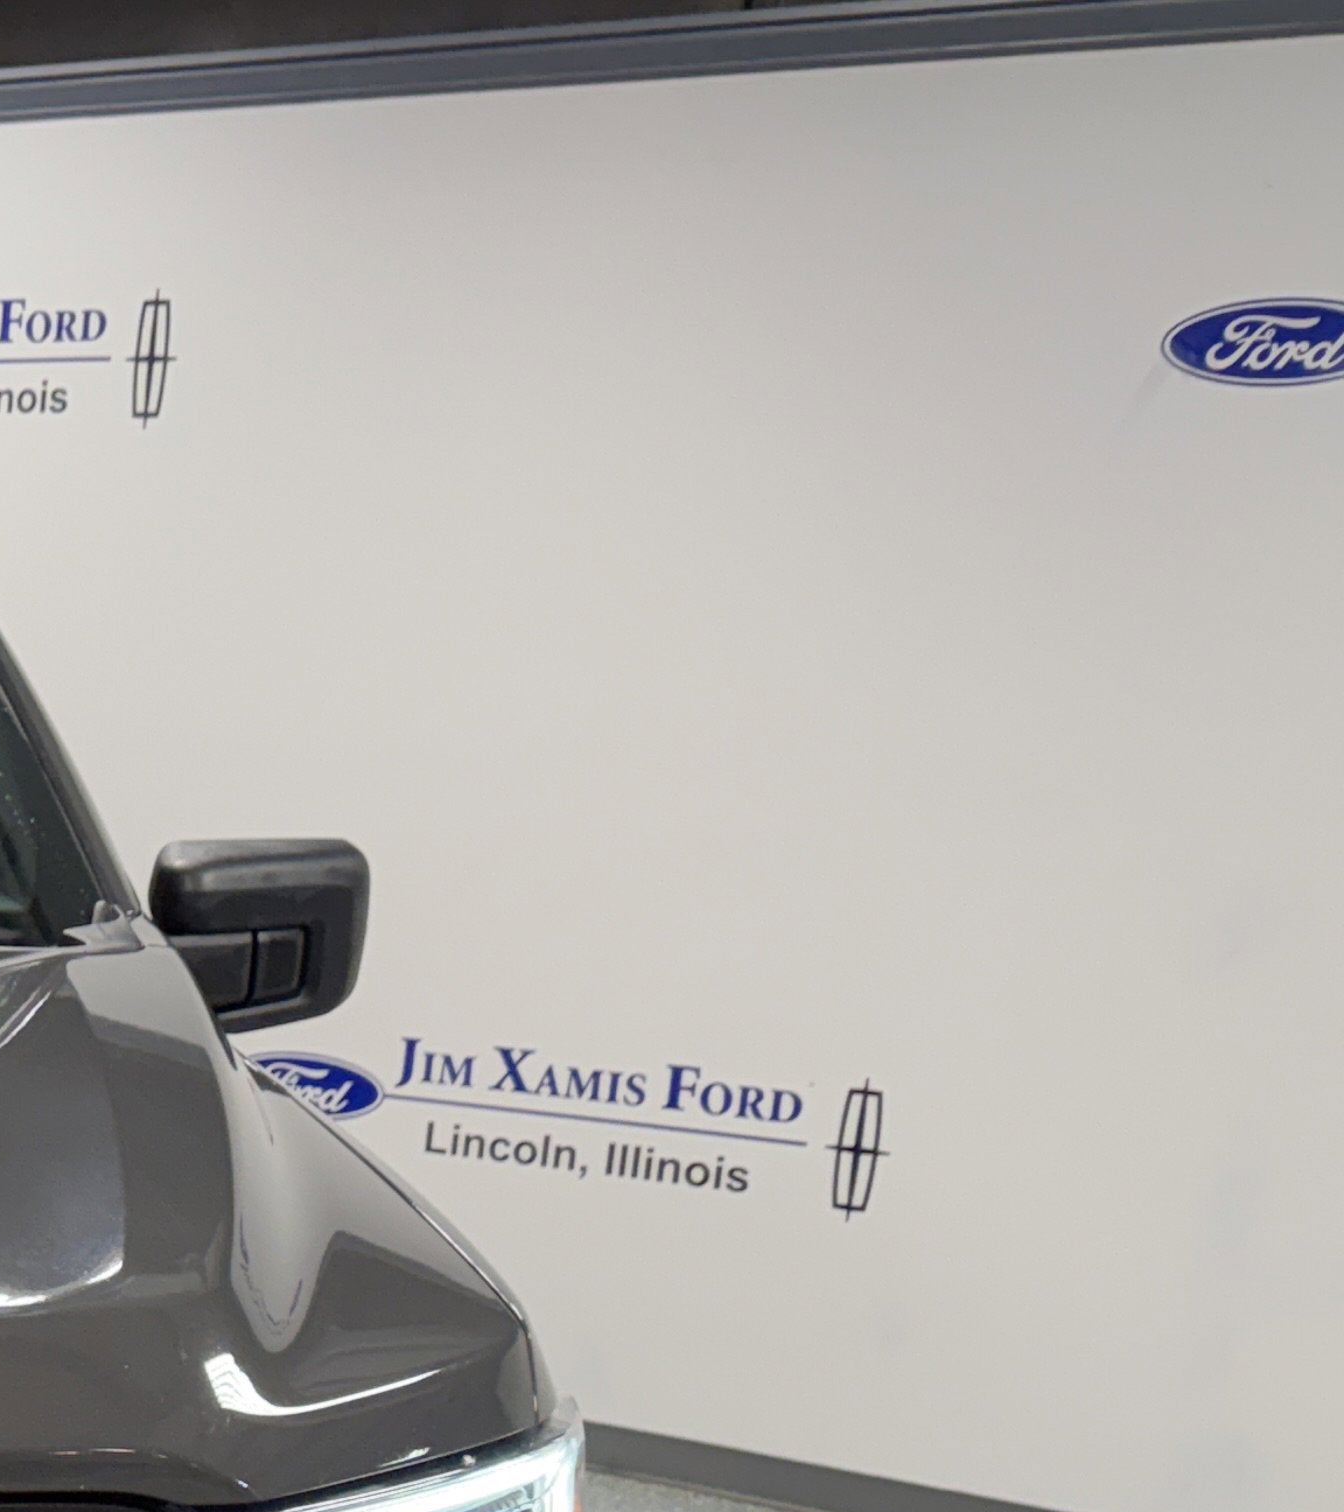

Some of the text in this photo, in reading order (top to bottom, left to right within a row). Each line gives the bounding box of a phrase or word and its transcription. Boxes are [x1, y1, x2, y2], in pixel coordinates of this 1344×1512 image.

[1205, 315, 1344, 370] Ford
[395, 1038, 803, 1125] JIM XAMIS FORD
[424, 1121, 750, 1193] Lincoln, Illinois
